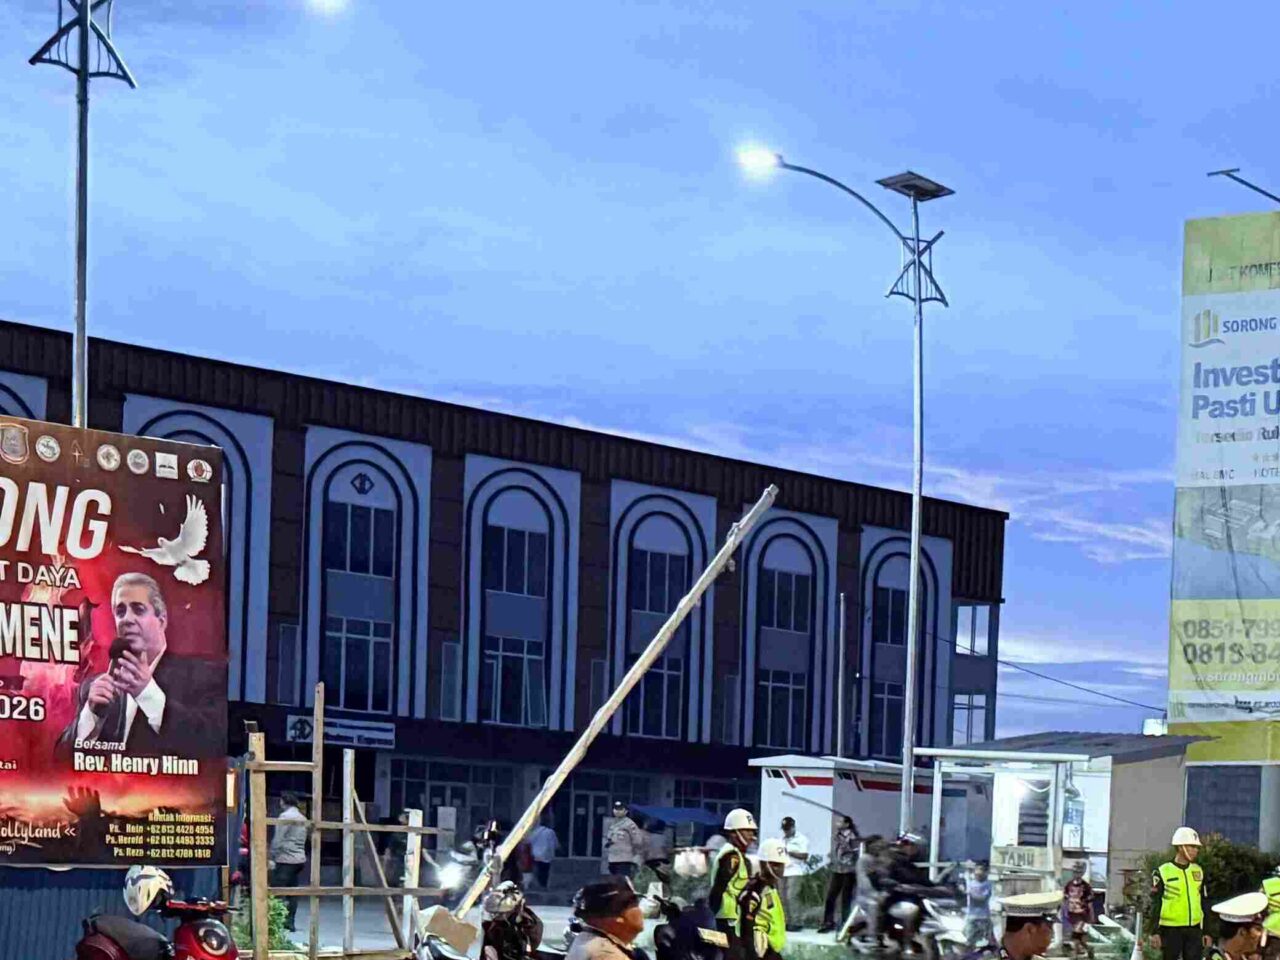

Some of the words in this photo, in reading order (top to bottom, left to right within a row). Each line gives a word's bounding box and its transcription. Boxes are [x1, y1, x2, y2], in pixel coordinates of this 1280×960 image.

[1222, 317, 1277, 333] SORONG
[1192, 392, 1256, 419] Pasti
[17, 562, 81, 589] DAYA
[74, 739, 127, 751] Bersama
[74, 752, 108, 771] Rev.
[111, 753, 159, 775] Henry
[162, 755, 198, 775] Hinn
